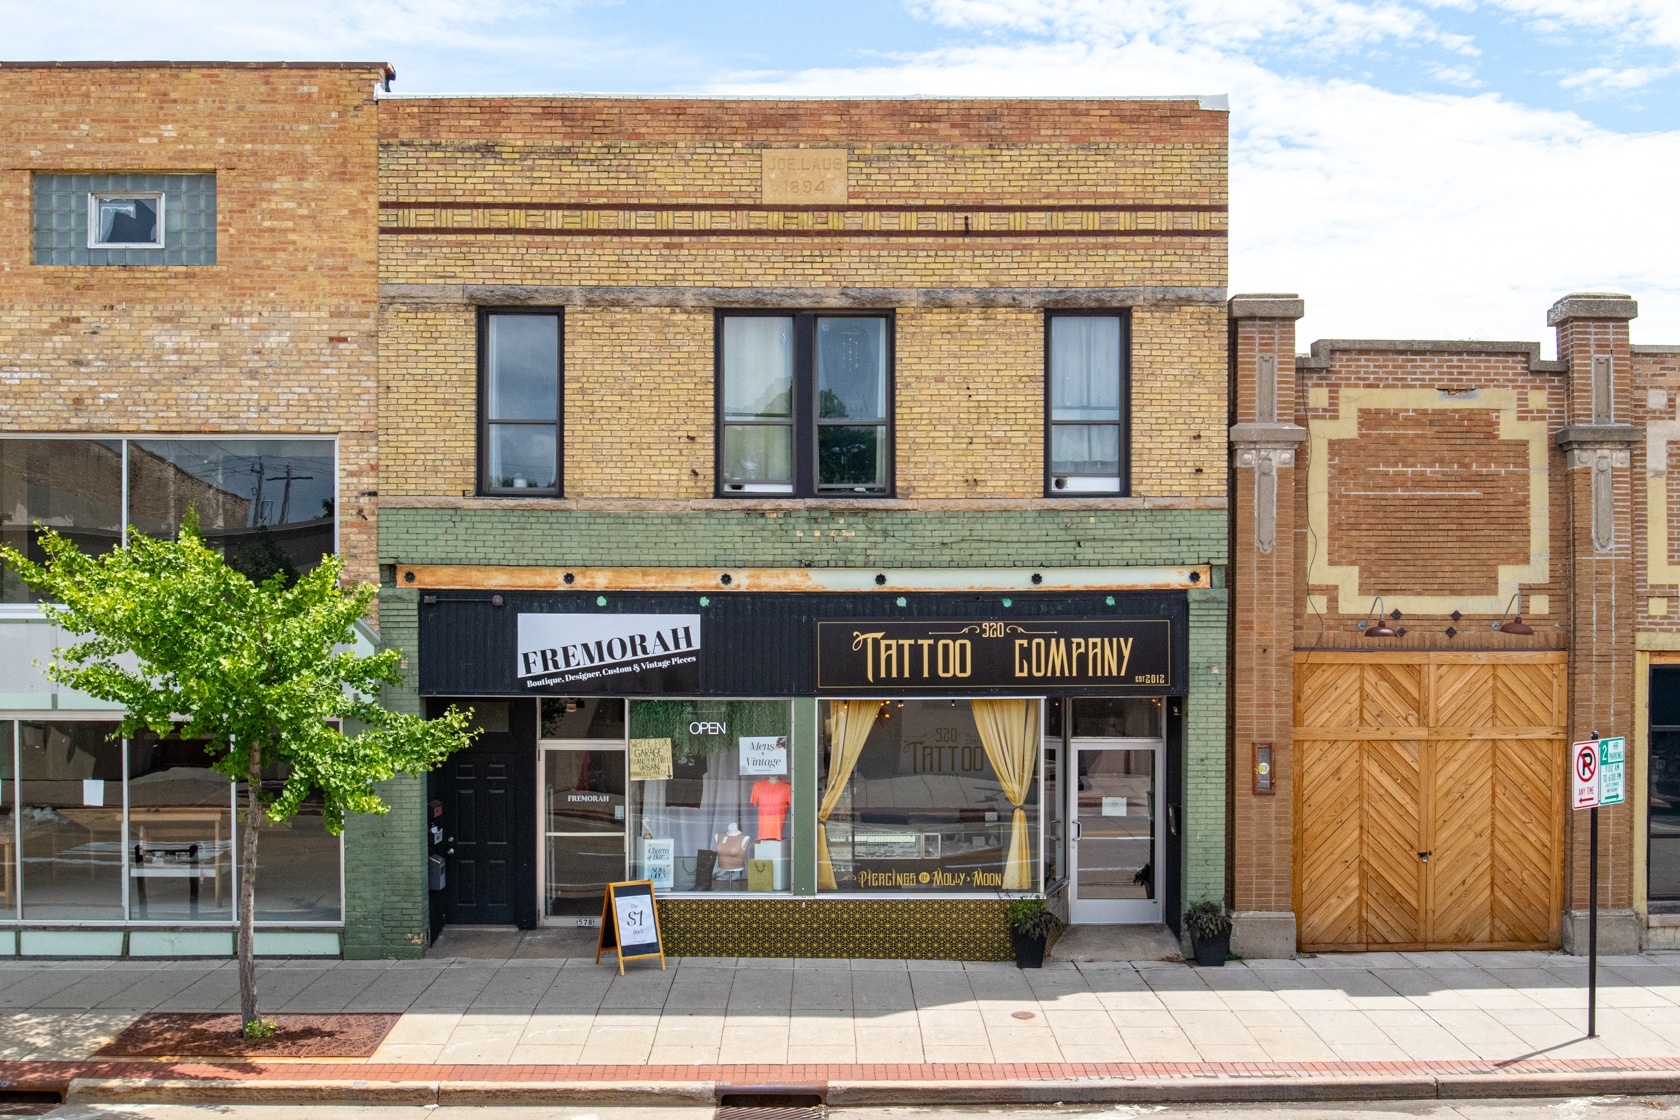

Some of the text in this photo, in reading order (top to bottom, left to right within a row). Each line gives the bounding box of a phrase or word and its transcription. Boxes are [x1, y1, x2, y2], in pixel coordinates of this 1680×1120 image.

[784, 180, 826, 194] 1894
[982, 622, 1005, 638] 920
[520, 625, 695, 675] FREMORAH
[852, 631, 1134, 683] TATTOO COMPANY
[526, 654, 697, 688] Boutique, Designer, Custom & Vintage Pieces
[689, 721, 726, 735] OPEN
[750, 741, 775, 751] Mens
[1601, 744, 1608, 761] 2
[746, 756, 782, 769] Vintage
[578, 918, 593, 926] 578
